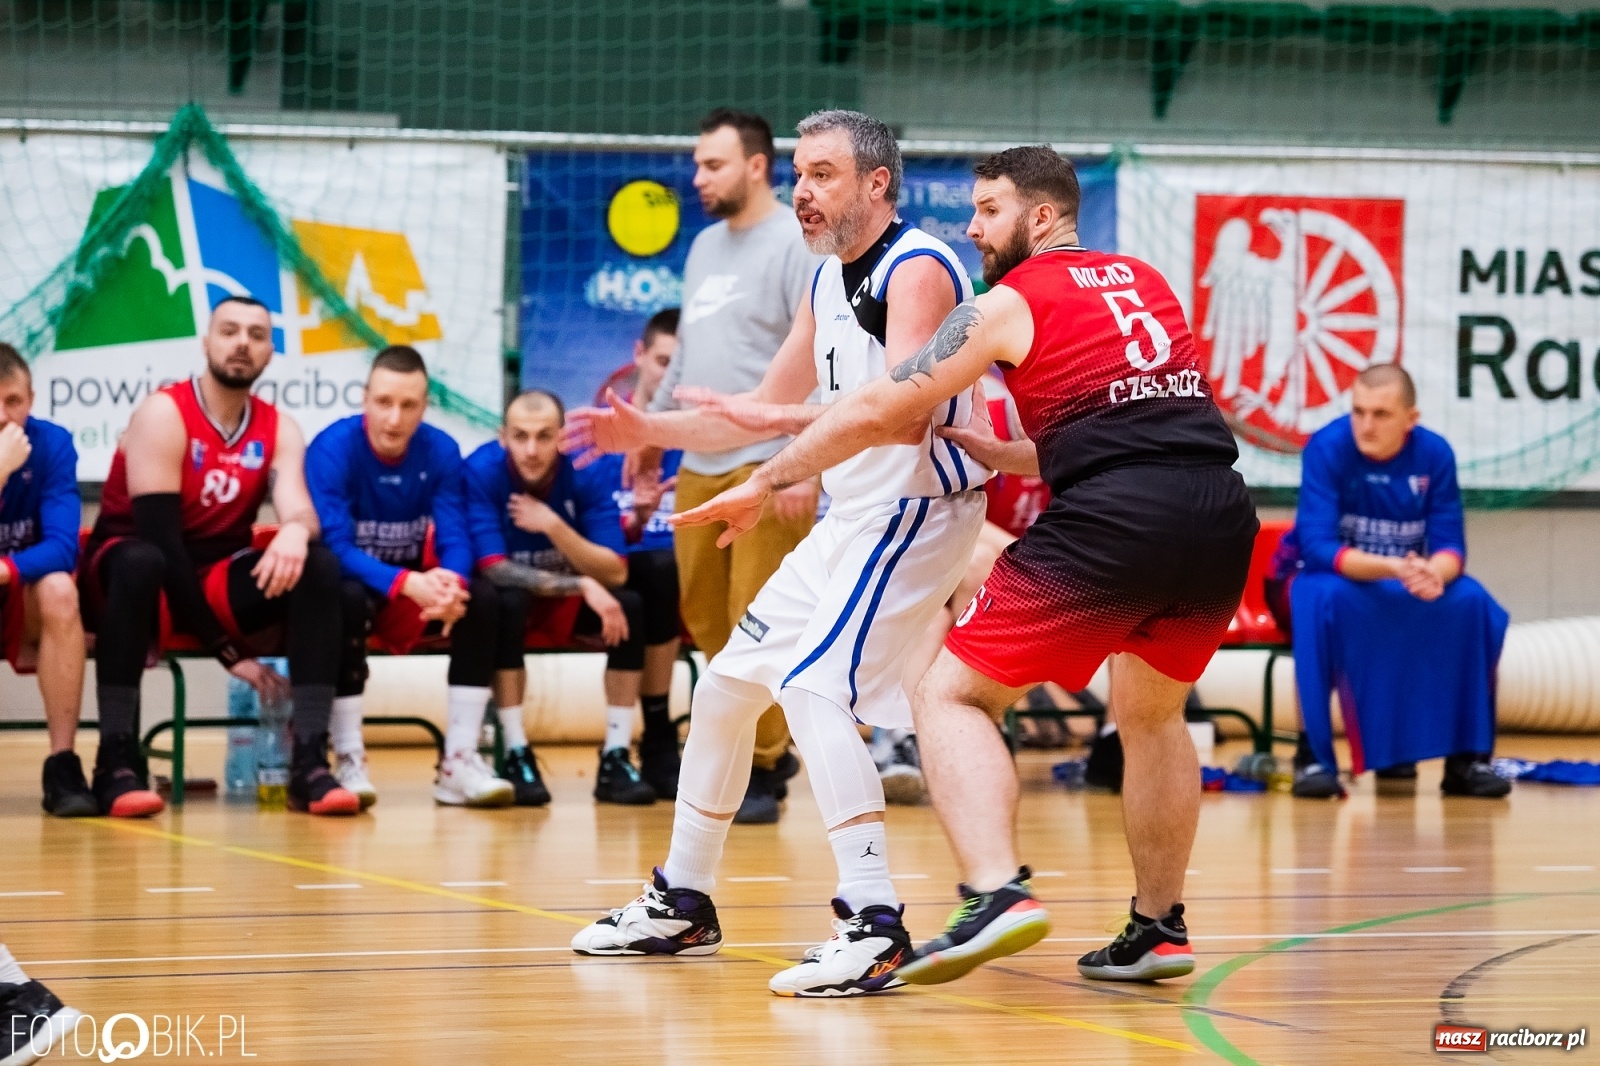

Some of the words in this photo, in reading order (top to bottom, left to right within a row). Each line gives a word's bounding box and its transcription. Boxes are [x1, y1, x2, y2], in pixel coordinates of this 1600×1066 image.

[1101, 288, 1172, 371] 5
[1458, 313, 1600, 402] Ra
[49, 365, 193, 417] powi
[255, 367, 367, 409] acibo
